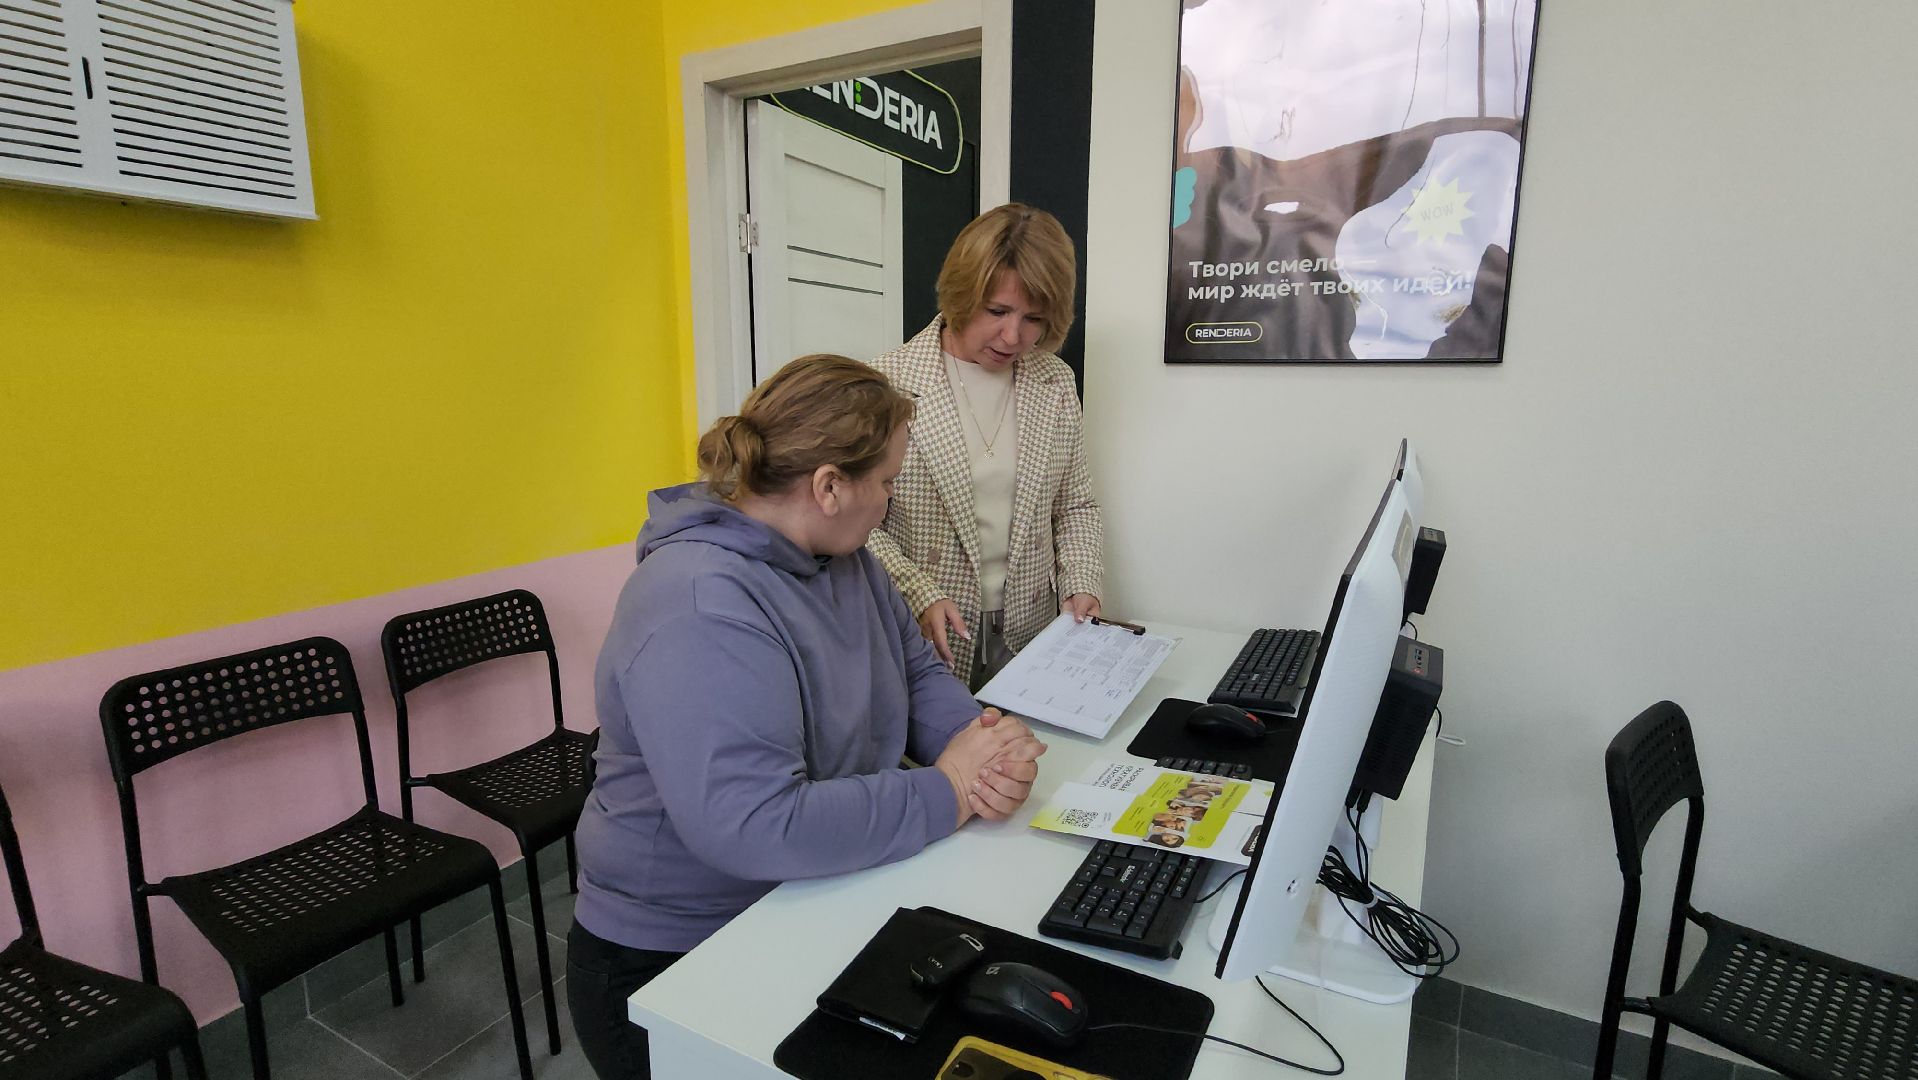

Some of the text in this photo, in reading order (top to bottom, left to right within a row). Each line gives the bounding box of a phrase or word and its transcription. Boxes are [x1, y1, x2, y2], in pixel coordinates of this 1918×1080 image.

[1420, 201, 1454, 221] WOW
[1189, 259, 1259, 280] Твори
[1266, 256, 1345, 275] смело
[1188, 270, 1472, 304] мир ждёт твоих идей!
[1195, 327, 1252, 338] RENDERIA
